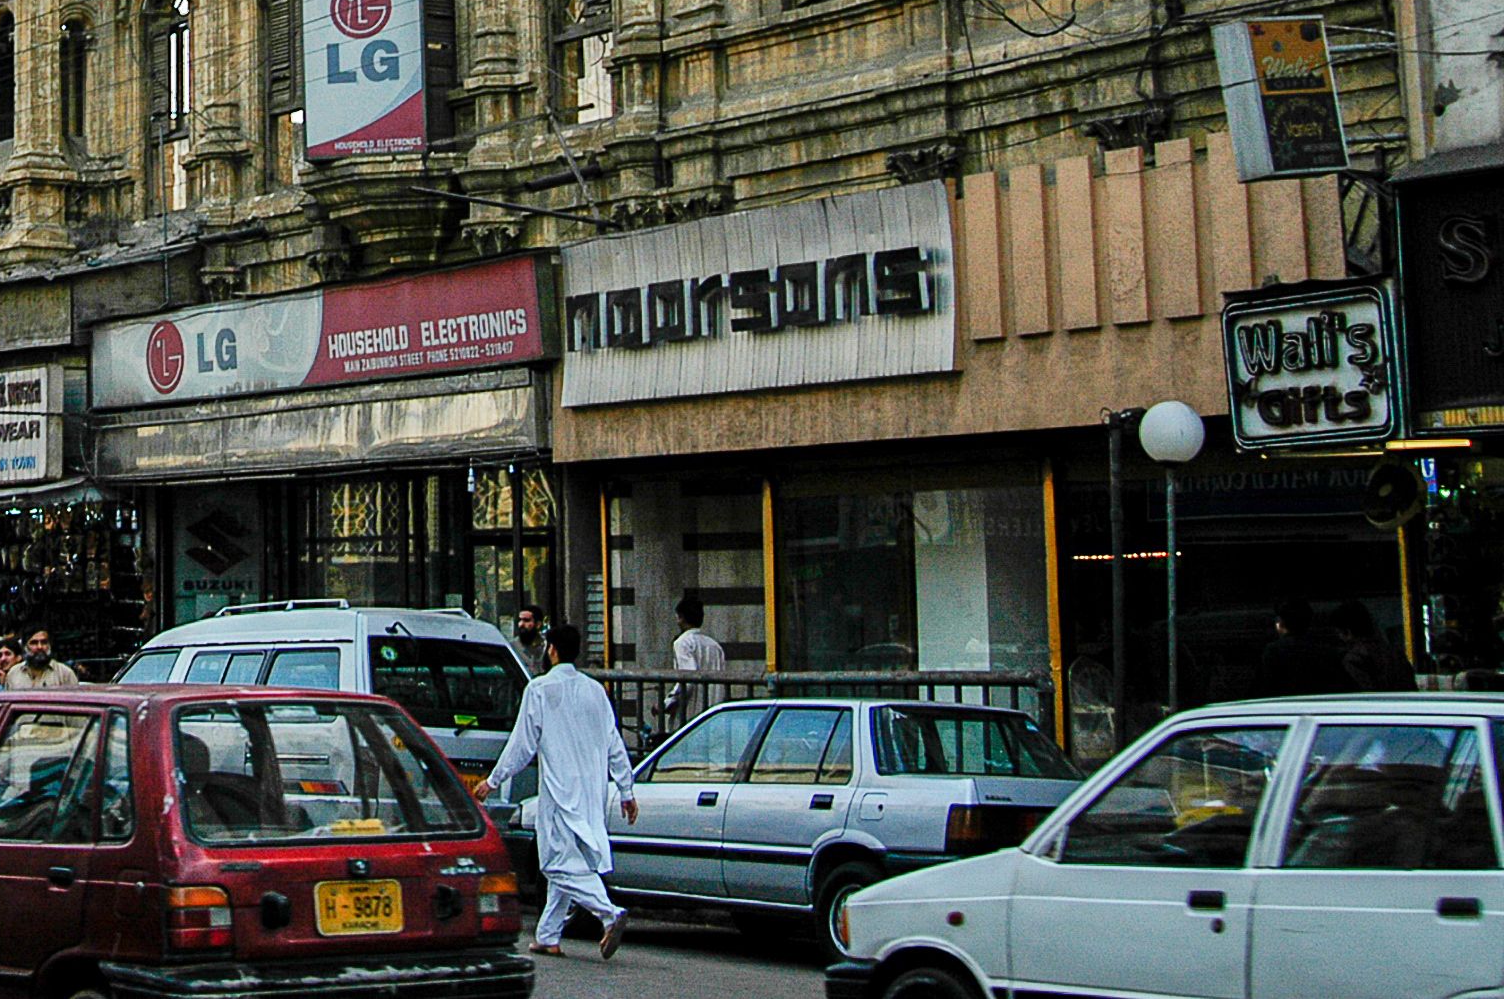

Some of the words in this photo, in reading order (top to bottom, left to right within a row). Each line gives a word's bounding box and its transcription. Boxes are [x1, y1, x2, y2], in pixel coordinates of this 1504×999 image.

[327, 39, 400, 84] LG
[196, 328, 238, 374] LG
[328, 324, 409, 360] HOUSEHOLD
[420, 308, 528, 348] ELECTRONICS
[1236, 310, 1379, 377] Wali's
[398, 353, 425, 367] STREET
[426, 348, 449, 364] PHONE
[183, 579, 254, 591] SUZUKI
